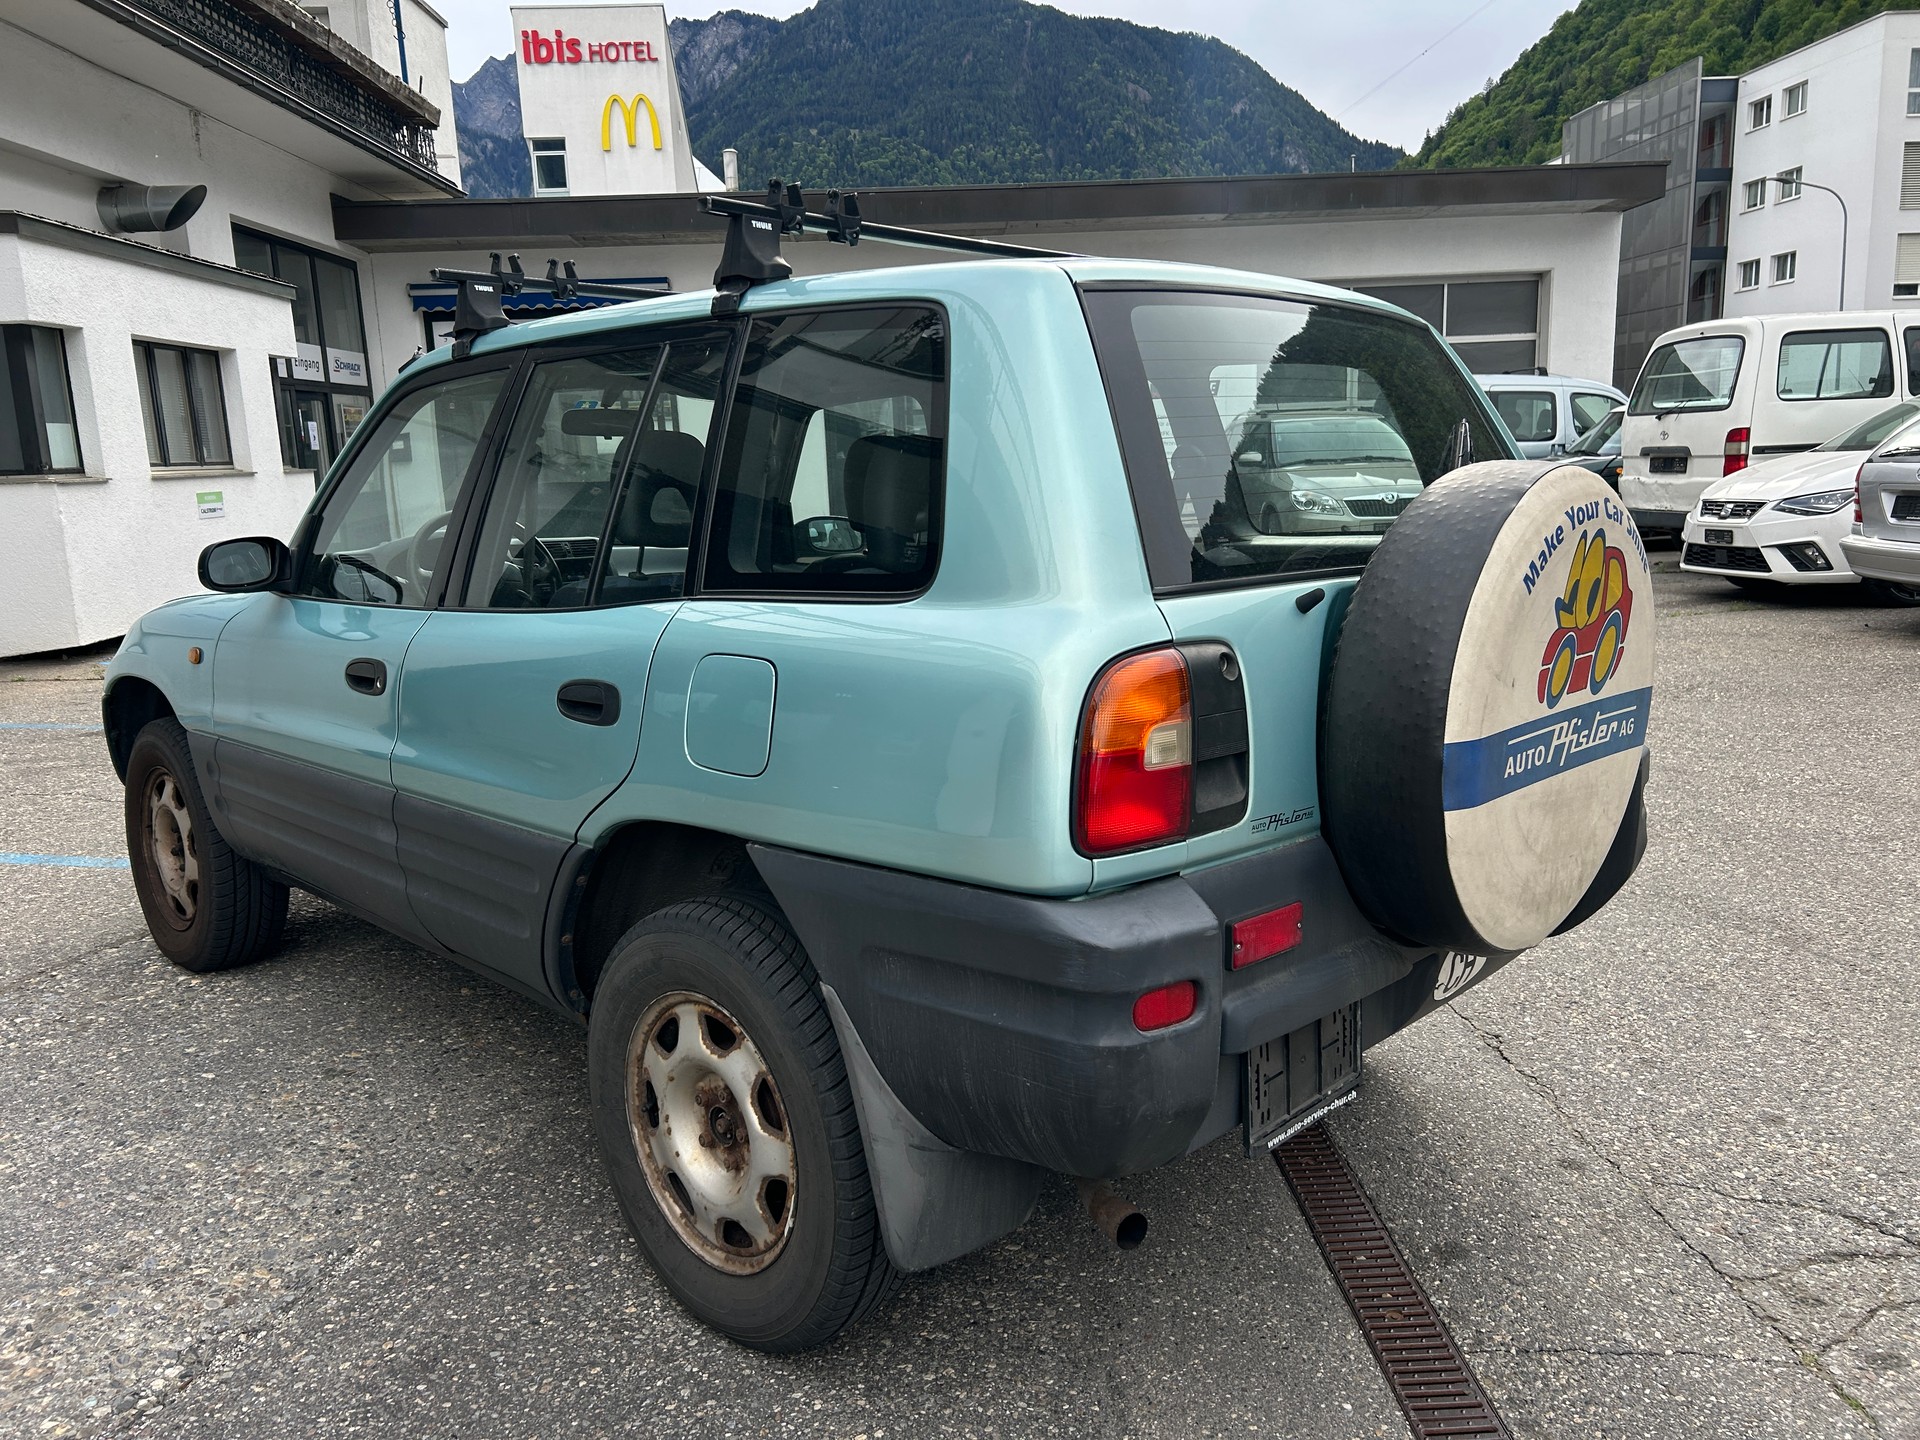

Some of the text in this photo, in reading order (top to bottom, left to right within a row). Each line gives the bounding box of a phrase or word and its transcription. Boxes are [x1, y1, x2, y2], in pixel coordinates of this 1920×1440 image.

[521, 30, 658, 65] ibis HOTEL
[751, 220, 773, 231] THULE
[1523, 525, 1565, 596] Make
[1565, 500, 1600, 531] Your
[1603, 497, 1624, 526] Car
[1504, 711, 1635, 779] AUTO Pfister AG
[1251, 822, 1267, 831] AUTO
[1267, 1089, 1357, 1149] www.auto-service-chur.ch
